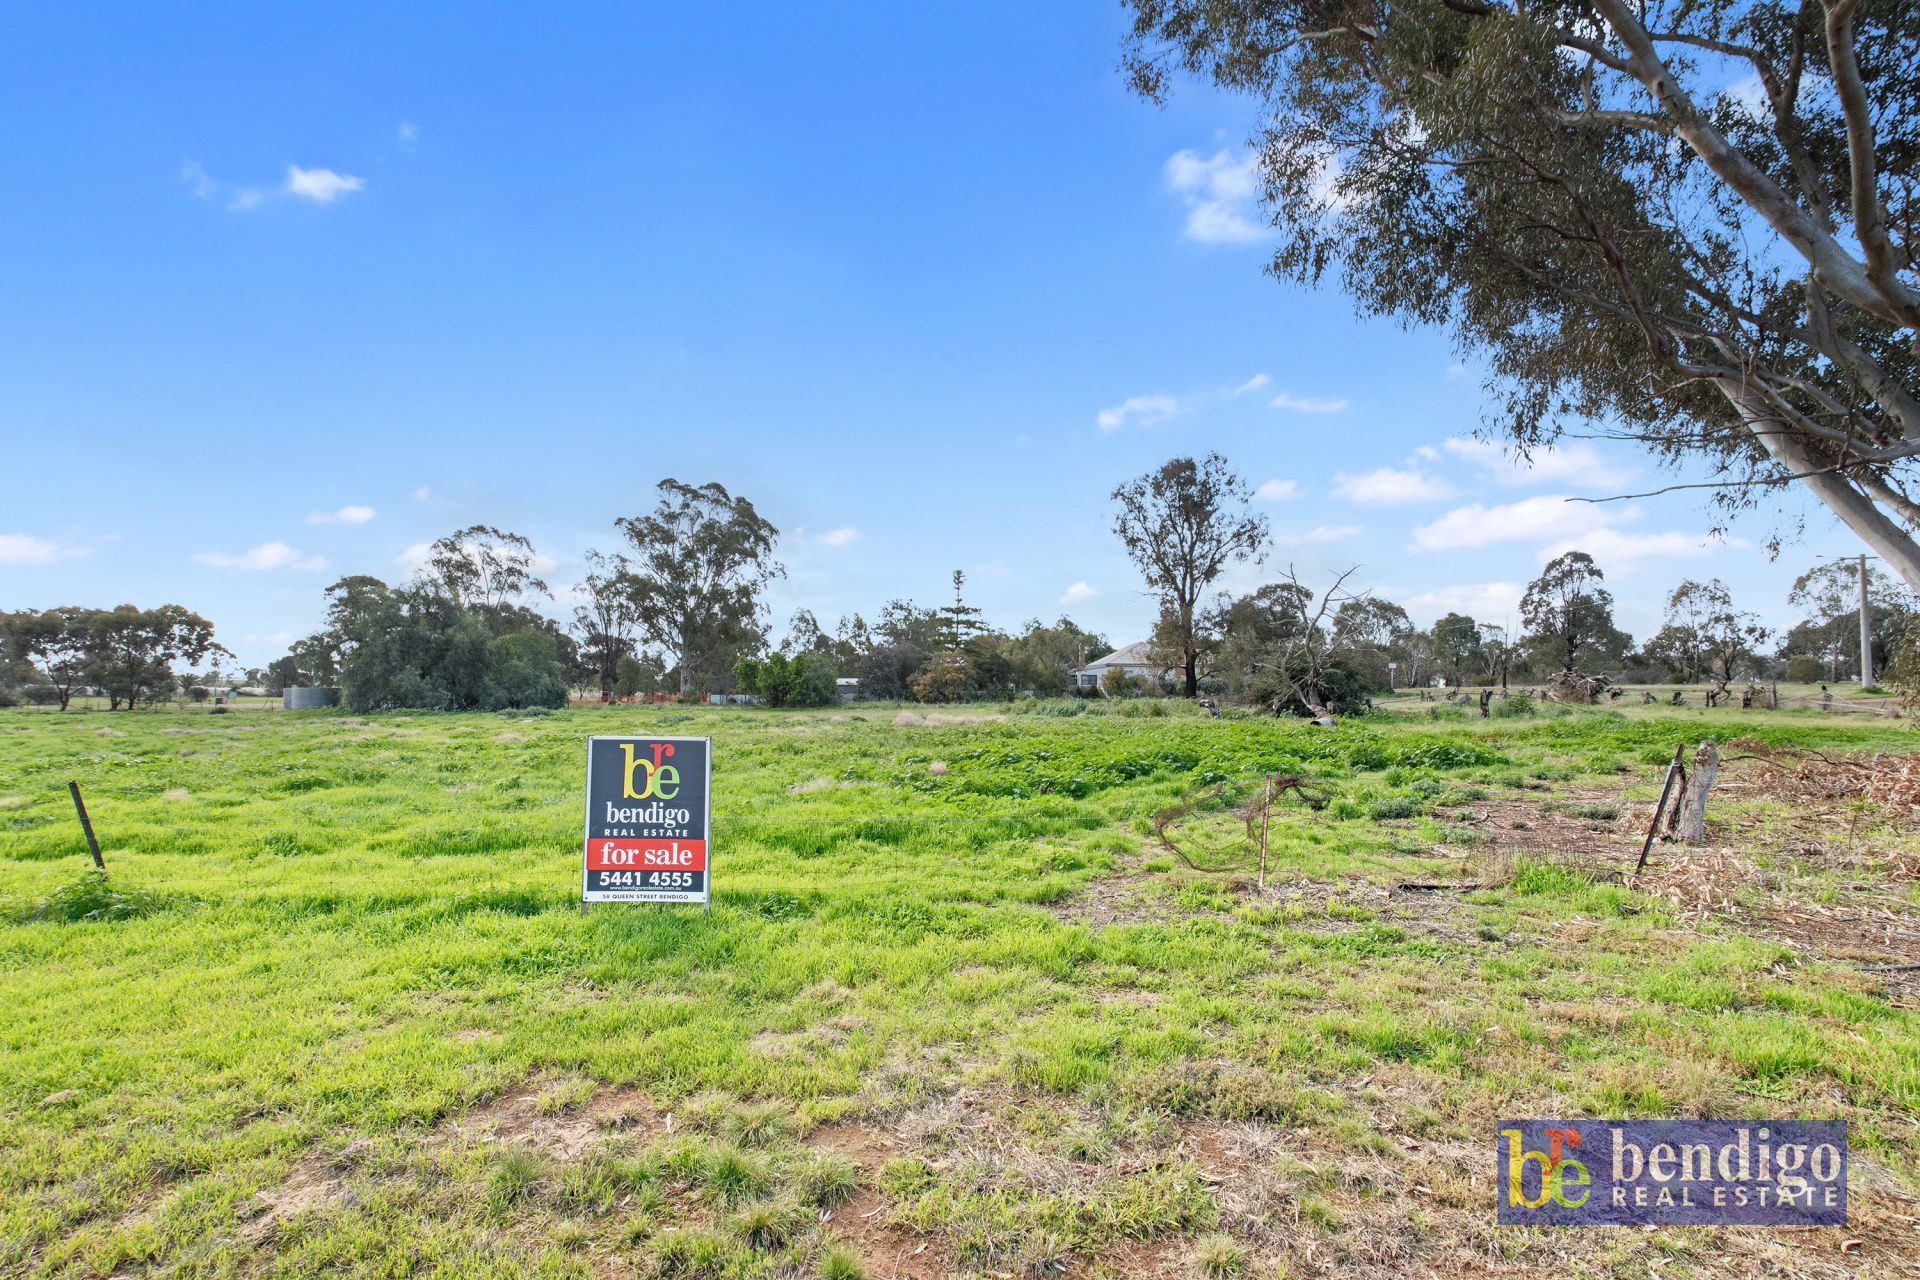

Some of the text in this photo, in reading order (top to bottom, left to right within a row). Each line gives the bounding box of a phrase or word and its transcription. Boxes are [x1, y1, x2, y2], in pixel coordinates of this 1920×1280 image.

[606, 802, 690, 828] bendigo
[600, 842, 693, 865] for sale
[599, 872, 692, 887] 5441 4555
